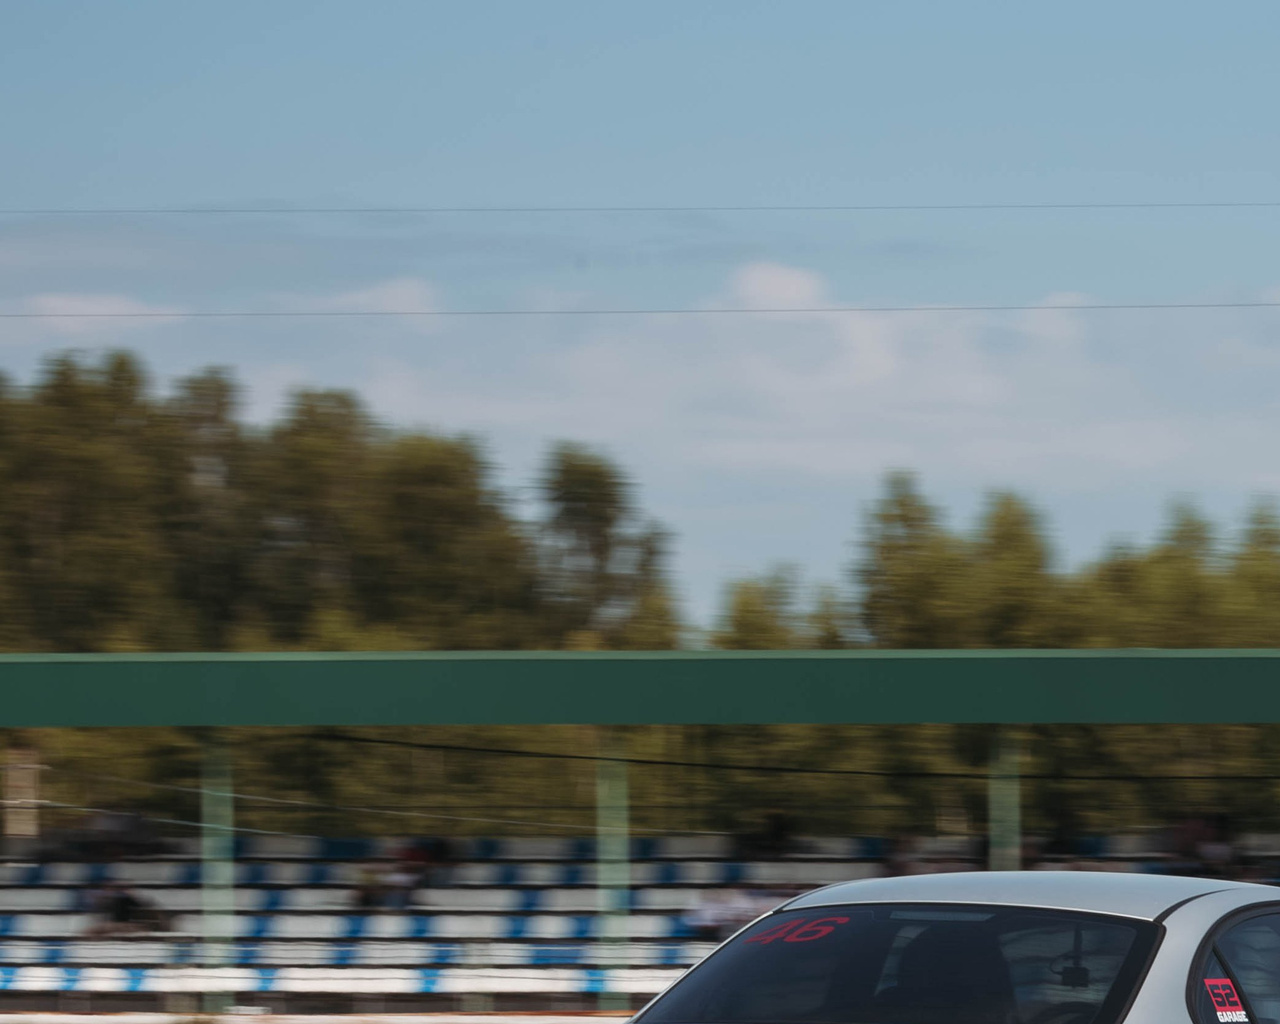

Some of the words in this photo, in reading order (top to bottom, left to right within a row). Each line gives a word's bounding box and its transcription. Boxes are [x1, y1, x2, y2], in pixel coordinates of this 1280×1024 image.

[743, 916, 850, 944] 46
[1208, 984, 1240, 1007] 52
[1216, 1011, 1249, 1023] GARAGE
